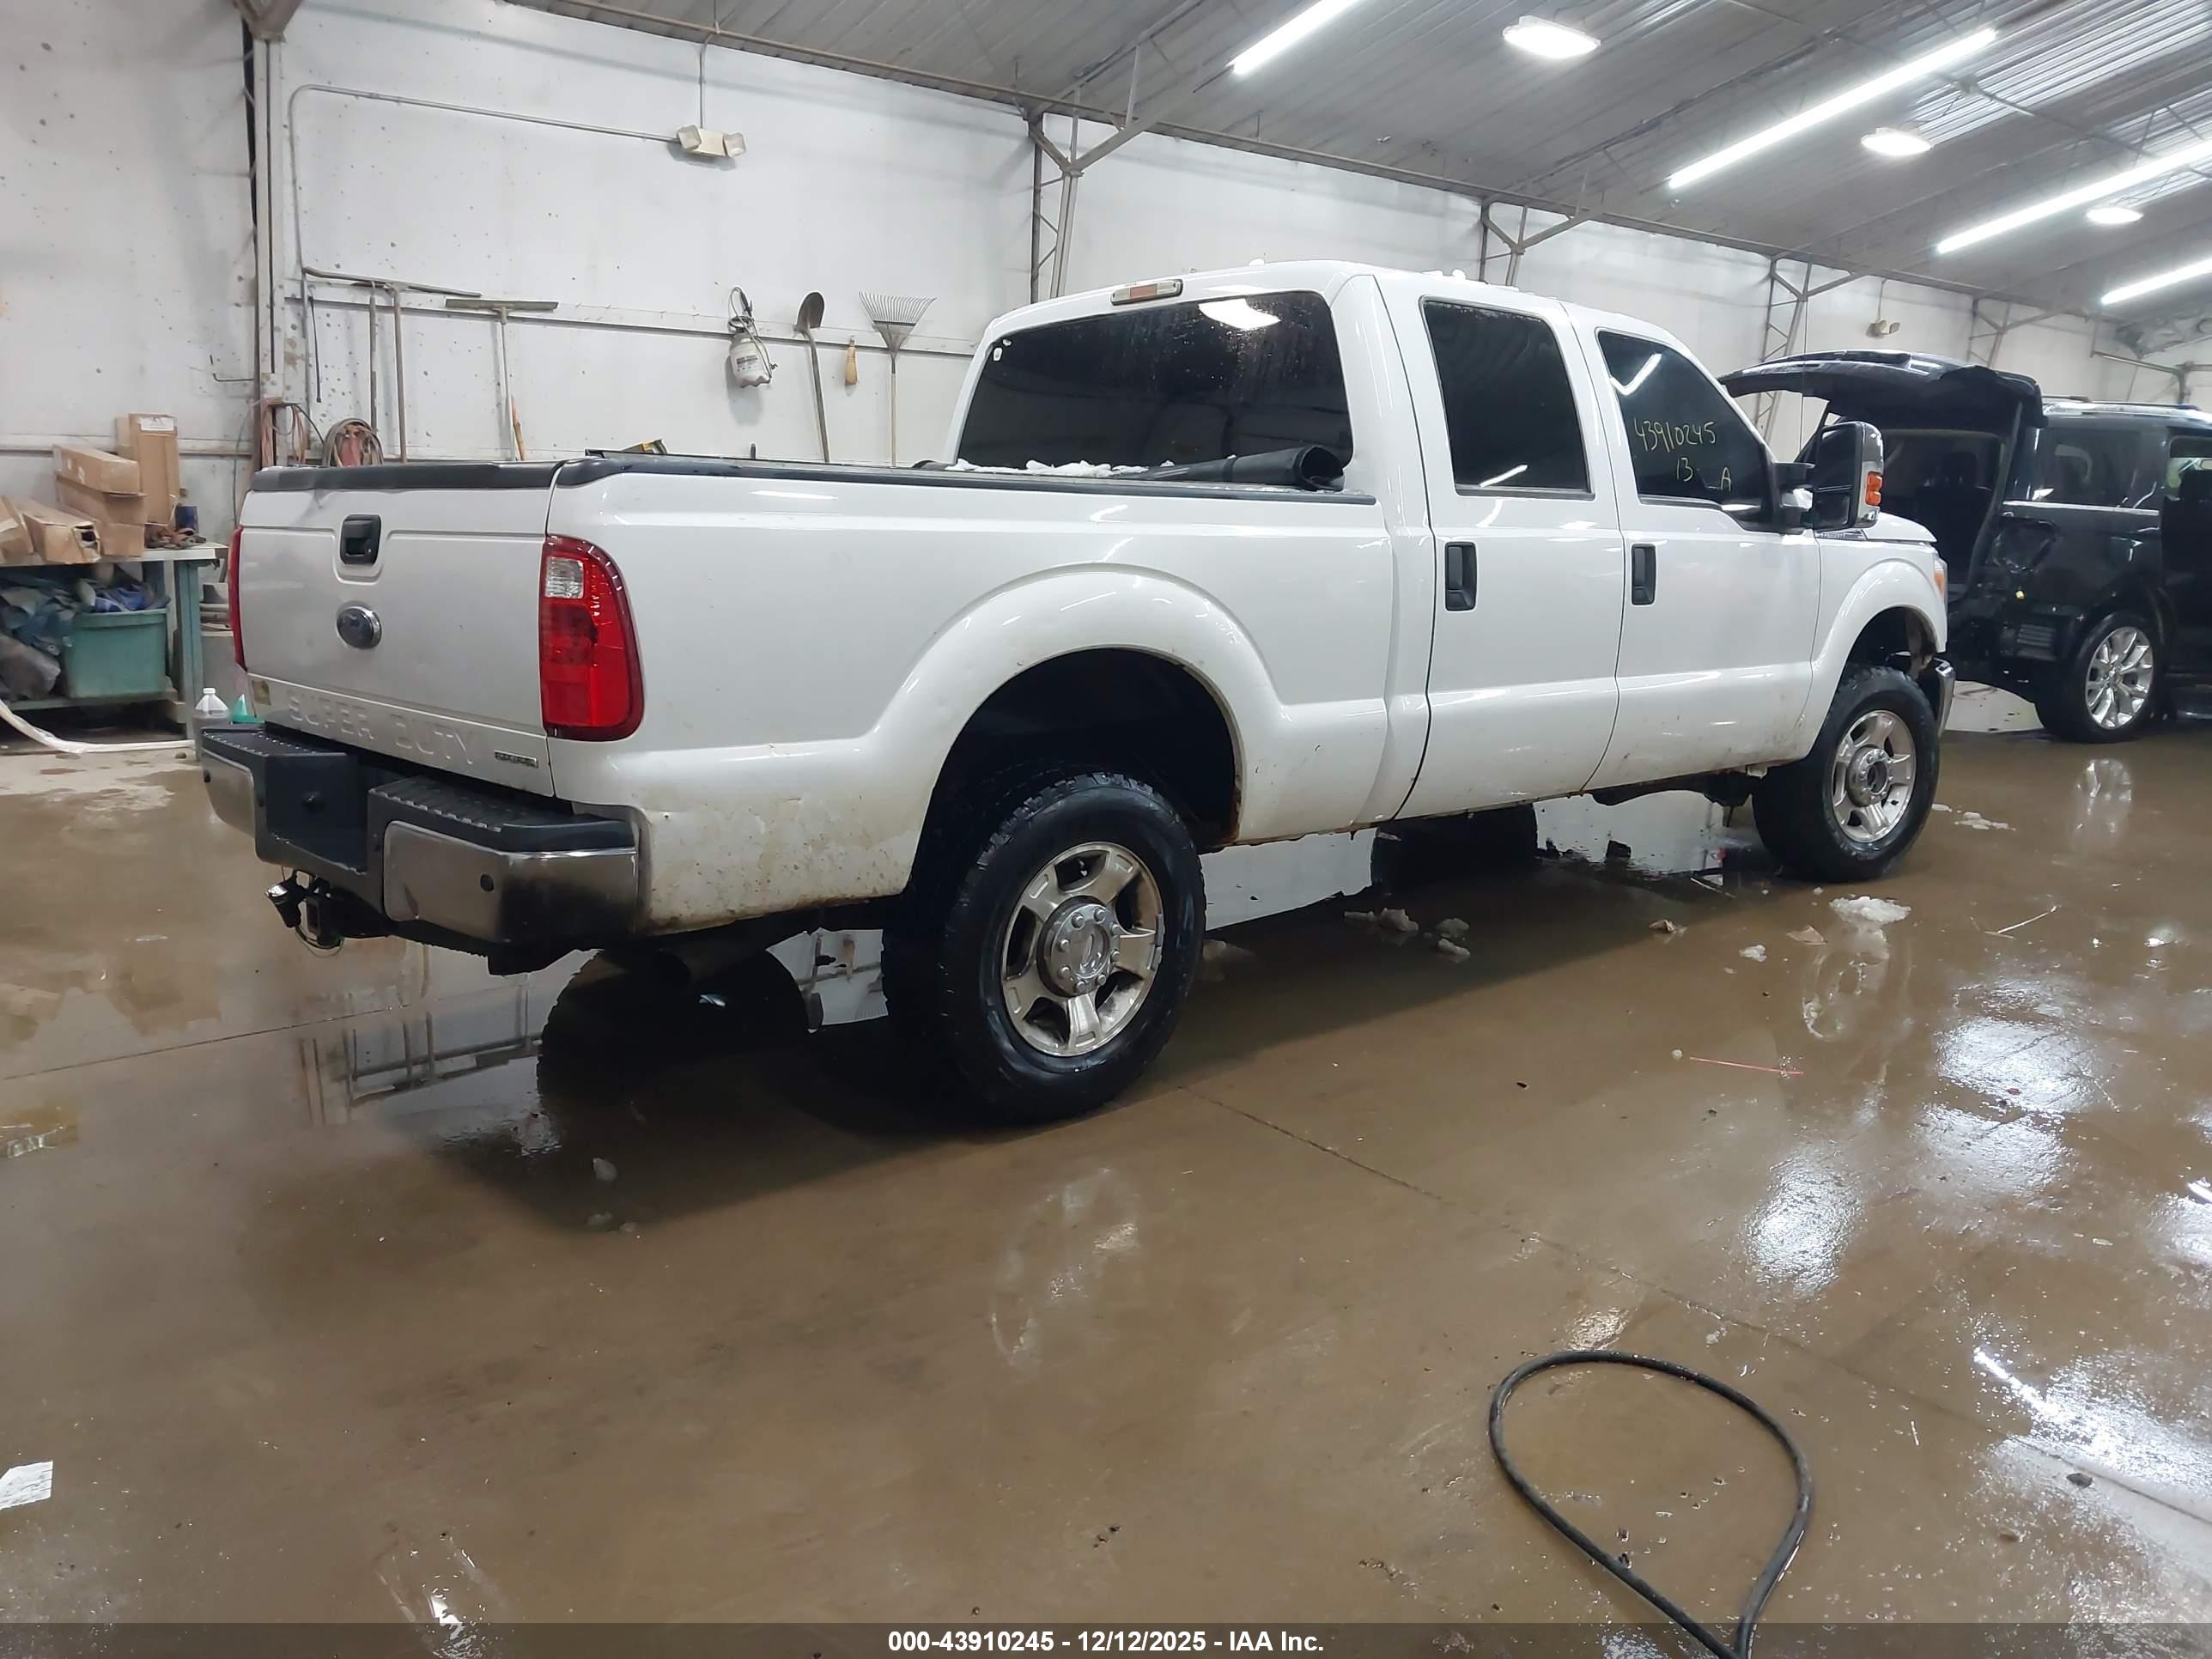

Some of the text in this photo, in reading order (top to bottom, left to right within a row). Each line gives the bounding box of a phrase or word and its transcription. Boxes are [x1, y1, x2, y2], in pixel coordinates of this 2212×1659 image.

[1633, 417, 1716, 453] 43910245
[1676, 457, 1694, 482] 13
[1720, 466, 1732, 492] A
[287, 690, 474, 765] SUPER DUTY
